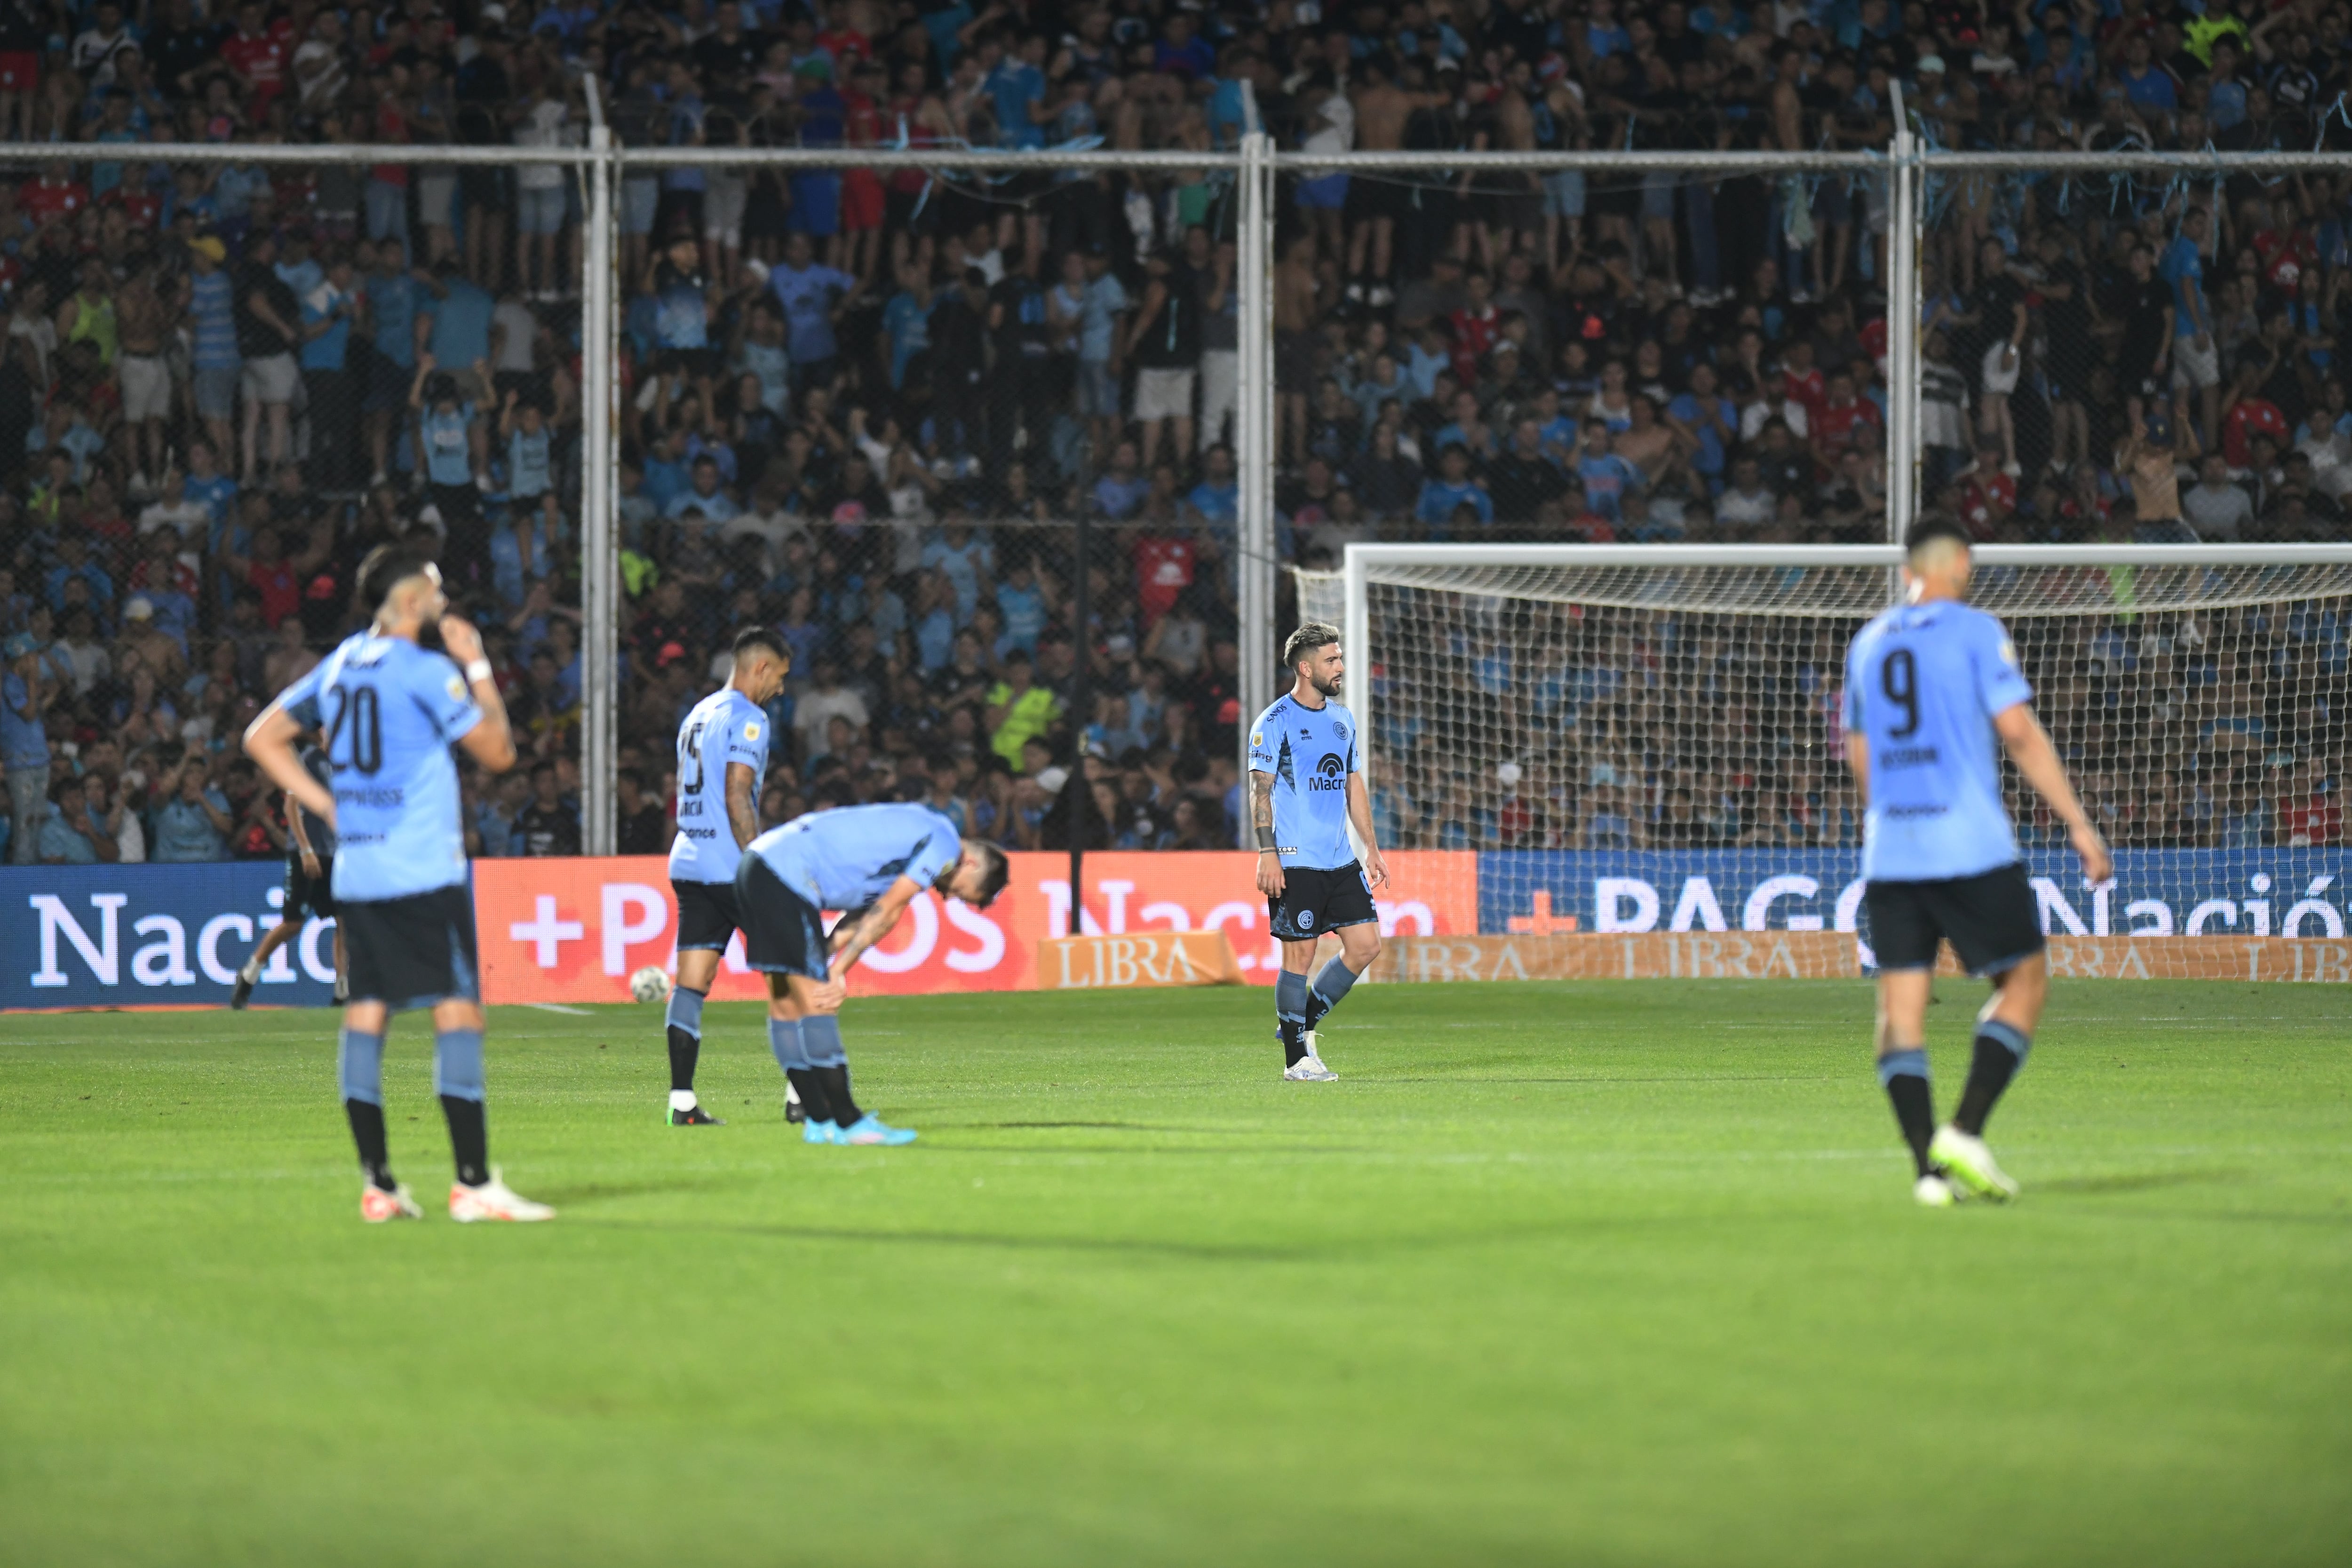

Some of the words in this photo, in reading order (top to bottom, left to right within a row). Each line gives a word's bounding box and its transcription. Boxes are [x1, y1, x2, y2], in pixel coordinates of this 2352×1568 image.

[1267, 704, 1287, 723] SANOS
[1883, 647, 1919, 739] 9
[329, 684, 382, 778] 20
[2028, 871, 2352, 939] Nació
[1057, 937, 1199, 988] LIBRA
[1620, 938, 1799, 979] LIBRA
[2243, 943, 2351, 982] LIB
